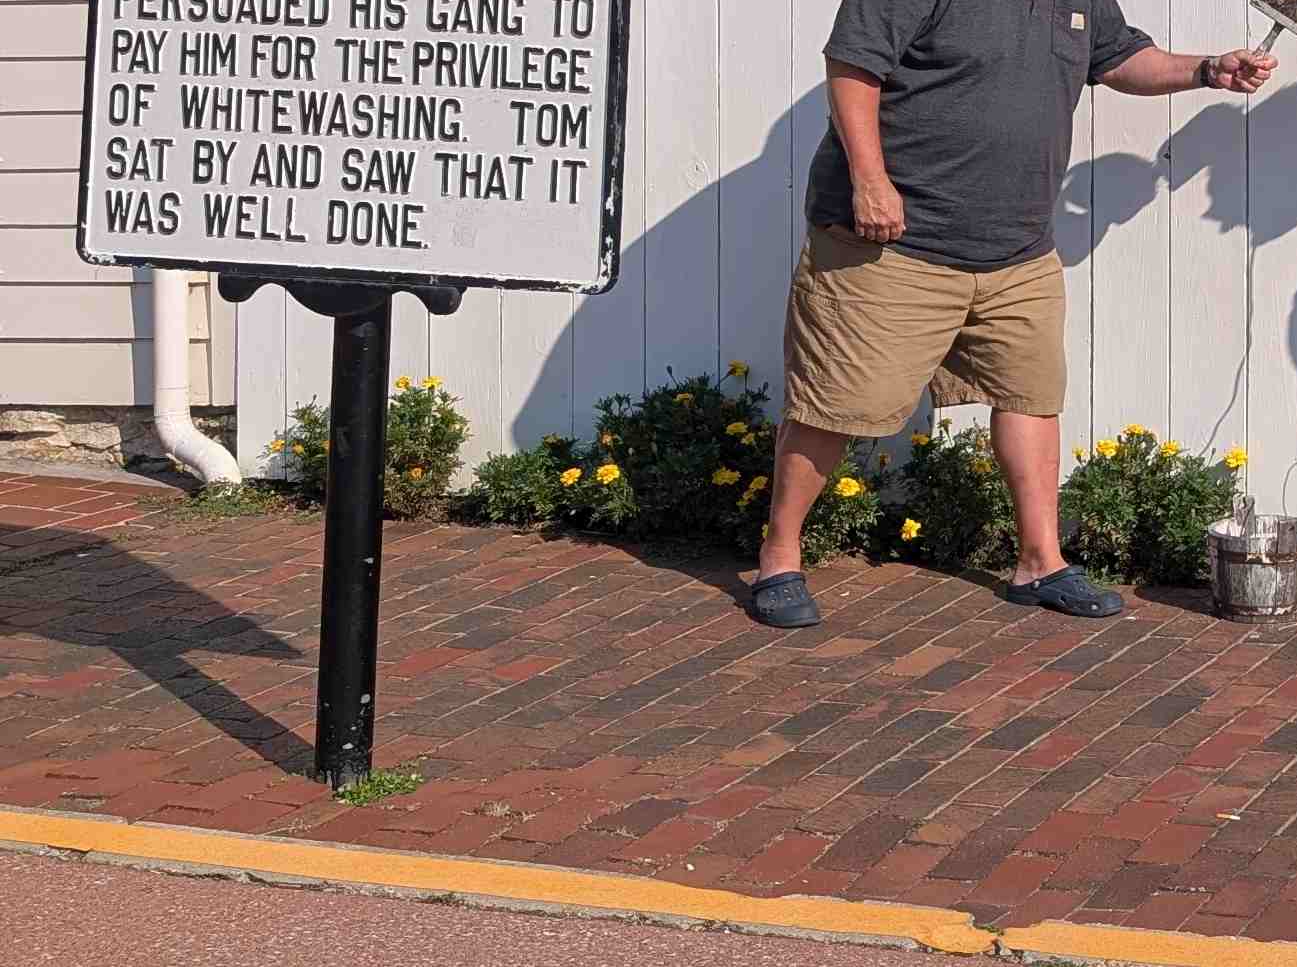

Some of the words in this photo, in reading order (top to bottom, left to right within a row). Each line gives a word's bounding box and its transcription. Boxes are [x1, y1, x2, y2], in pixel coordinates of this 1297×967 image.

[110, 29, 169, 75] PAY
[179, 31, 238, 78] HIM
[249, 34, 317, 82] FOR
[333, 38, 406, 85] THE
[411, 41, 592, 95] PRIVILEGE
[108, 83, 156, 128] OF
[179, 84, 469, 144] WHITEWASHING.
[509, 100, 590, 151] TOM
[105, 136, 174, 183] SAT
[192, 139, 238, 186] BY
[249, 143, 323, 191] AND
[340, 148, 417, 196] SAW
[433, 152, 534, 202] THAT
[548, 159, 589, 205] IT
[104, 190, 181, 237] WAS
[203, 193, 307, 244] WELL
[325, 199, 431, 251] DONE.
